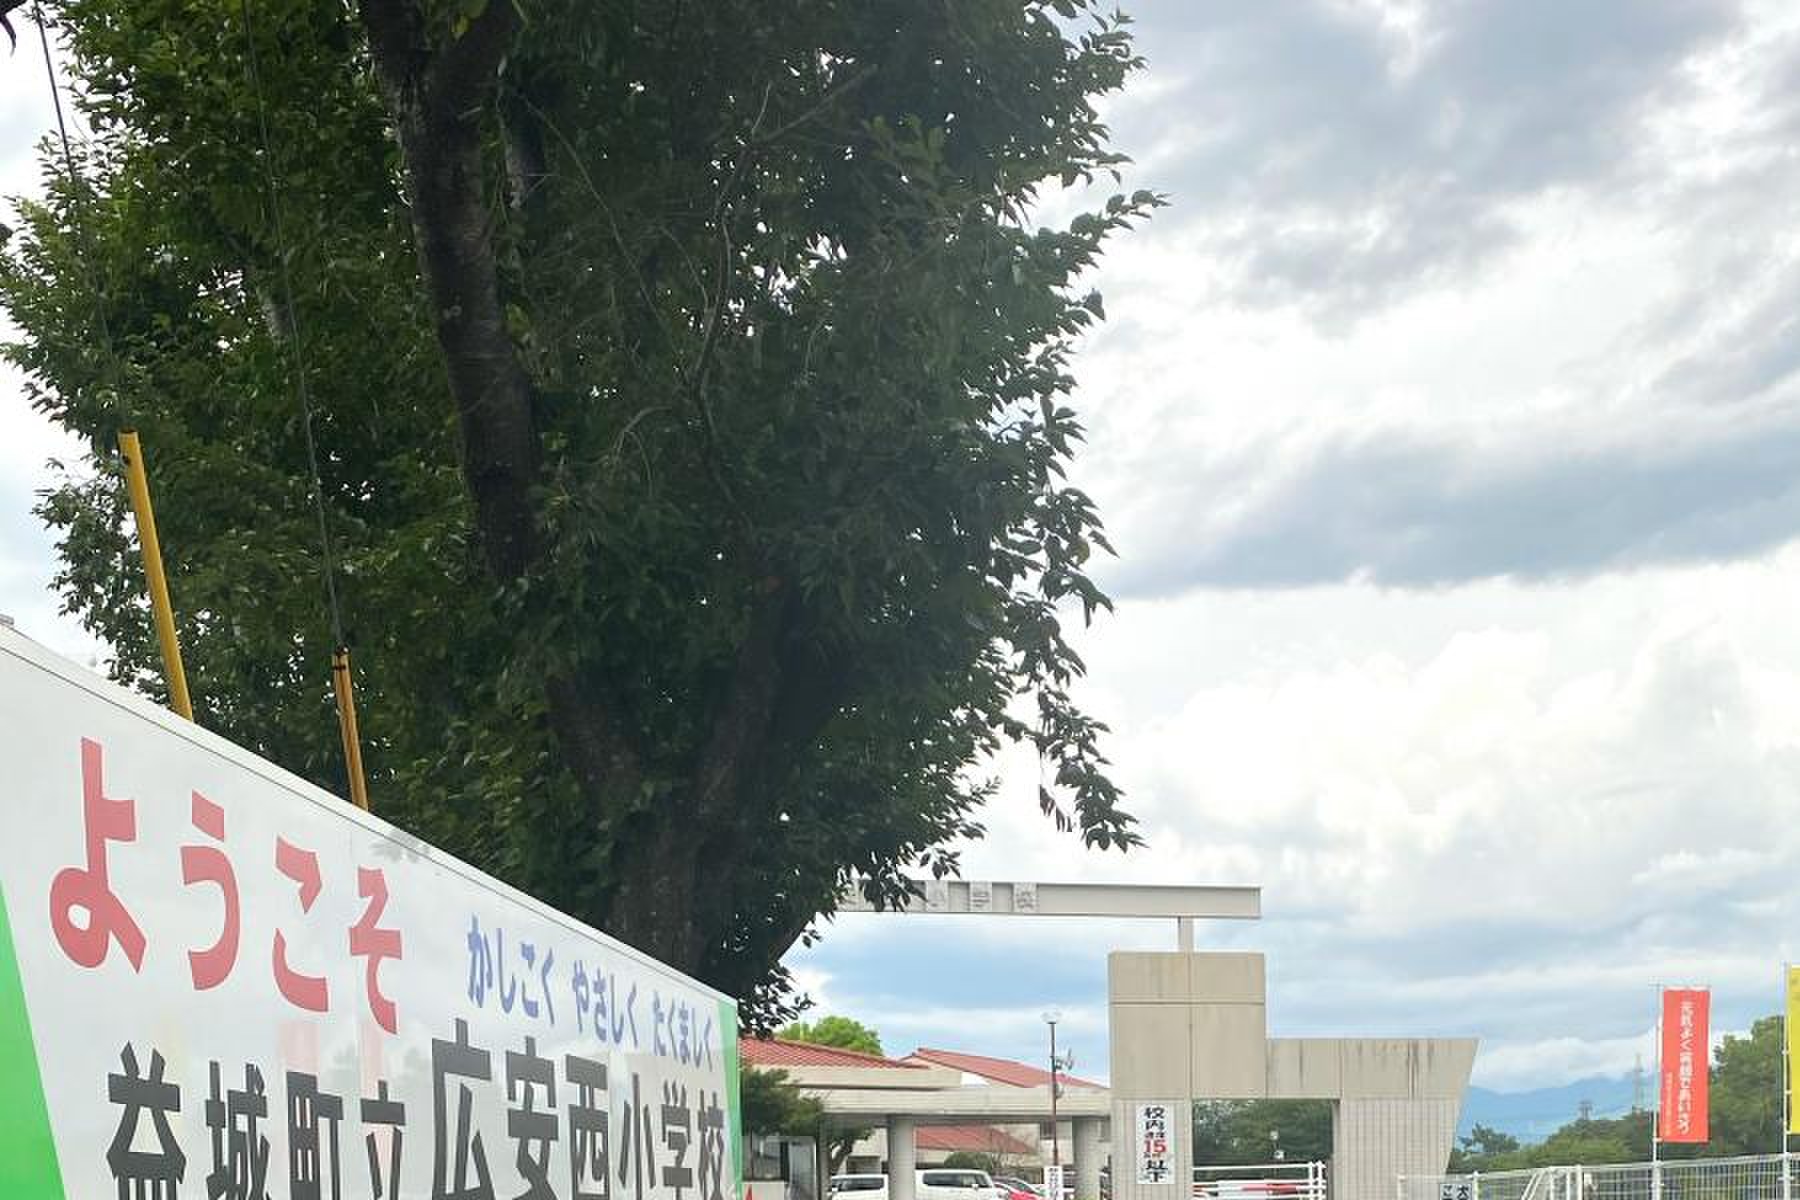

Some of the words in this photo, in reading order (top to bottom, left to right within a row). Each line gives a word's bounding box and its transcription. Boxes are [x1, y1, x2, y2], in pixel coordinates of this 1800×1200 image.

[50, 737, 402, 1034] ようこそ
[468, 914, 555, 1026] かしこく
[571, 959, 638, 1047] やさしく
[653, 989, 713, 1072] たくましく
